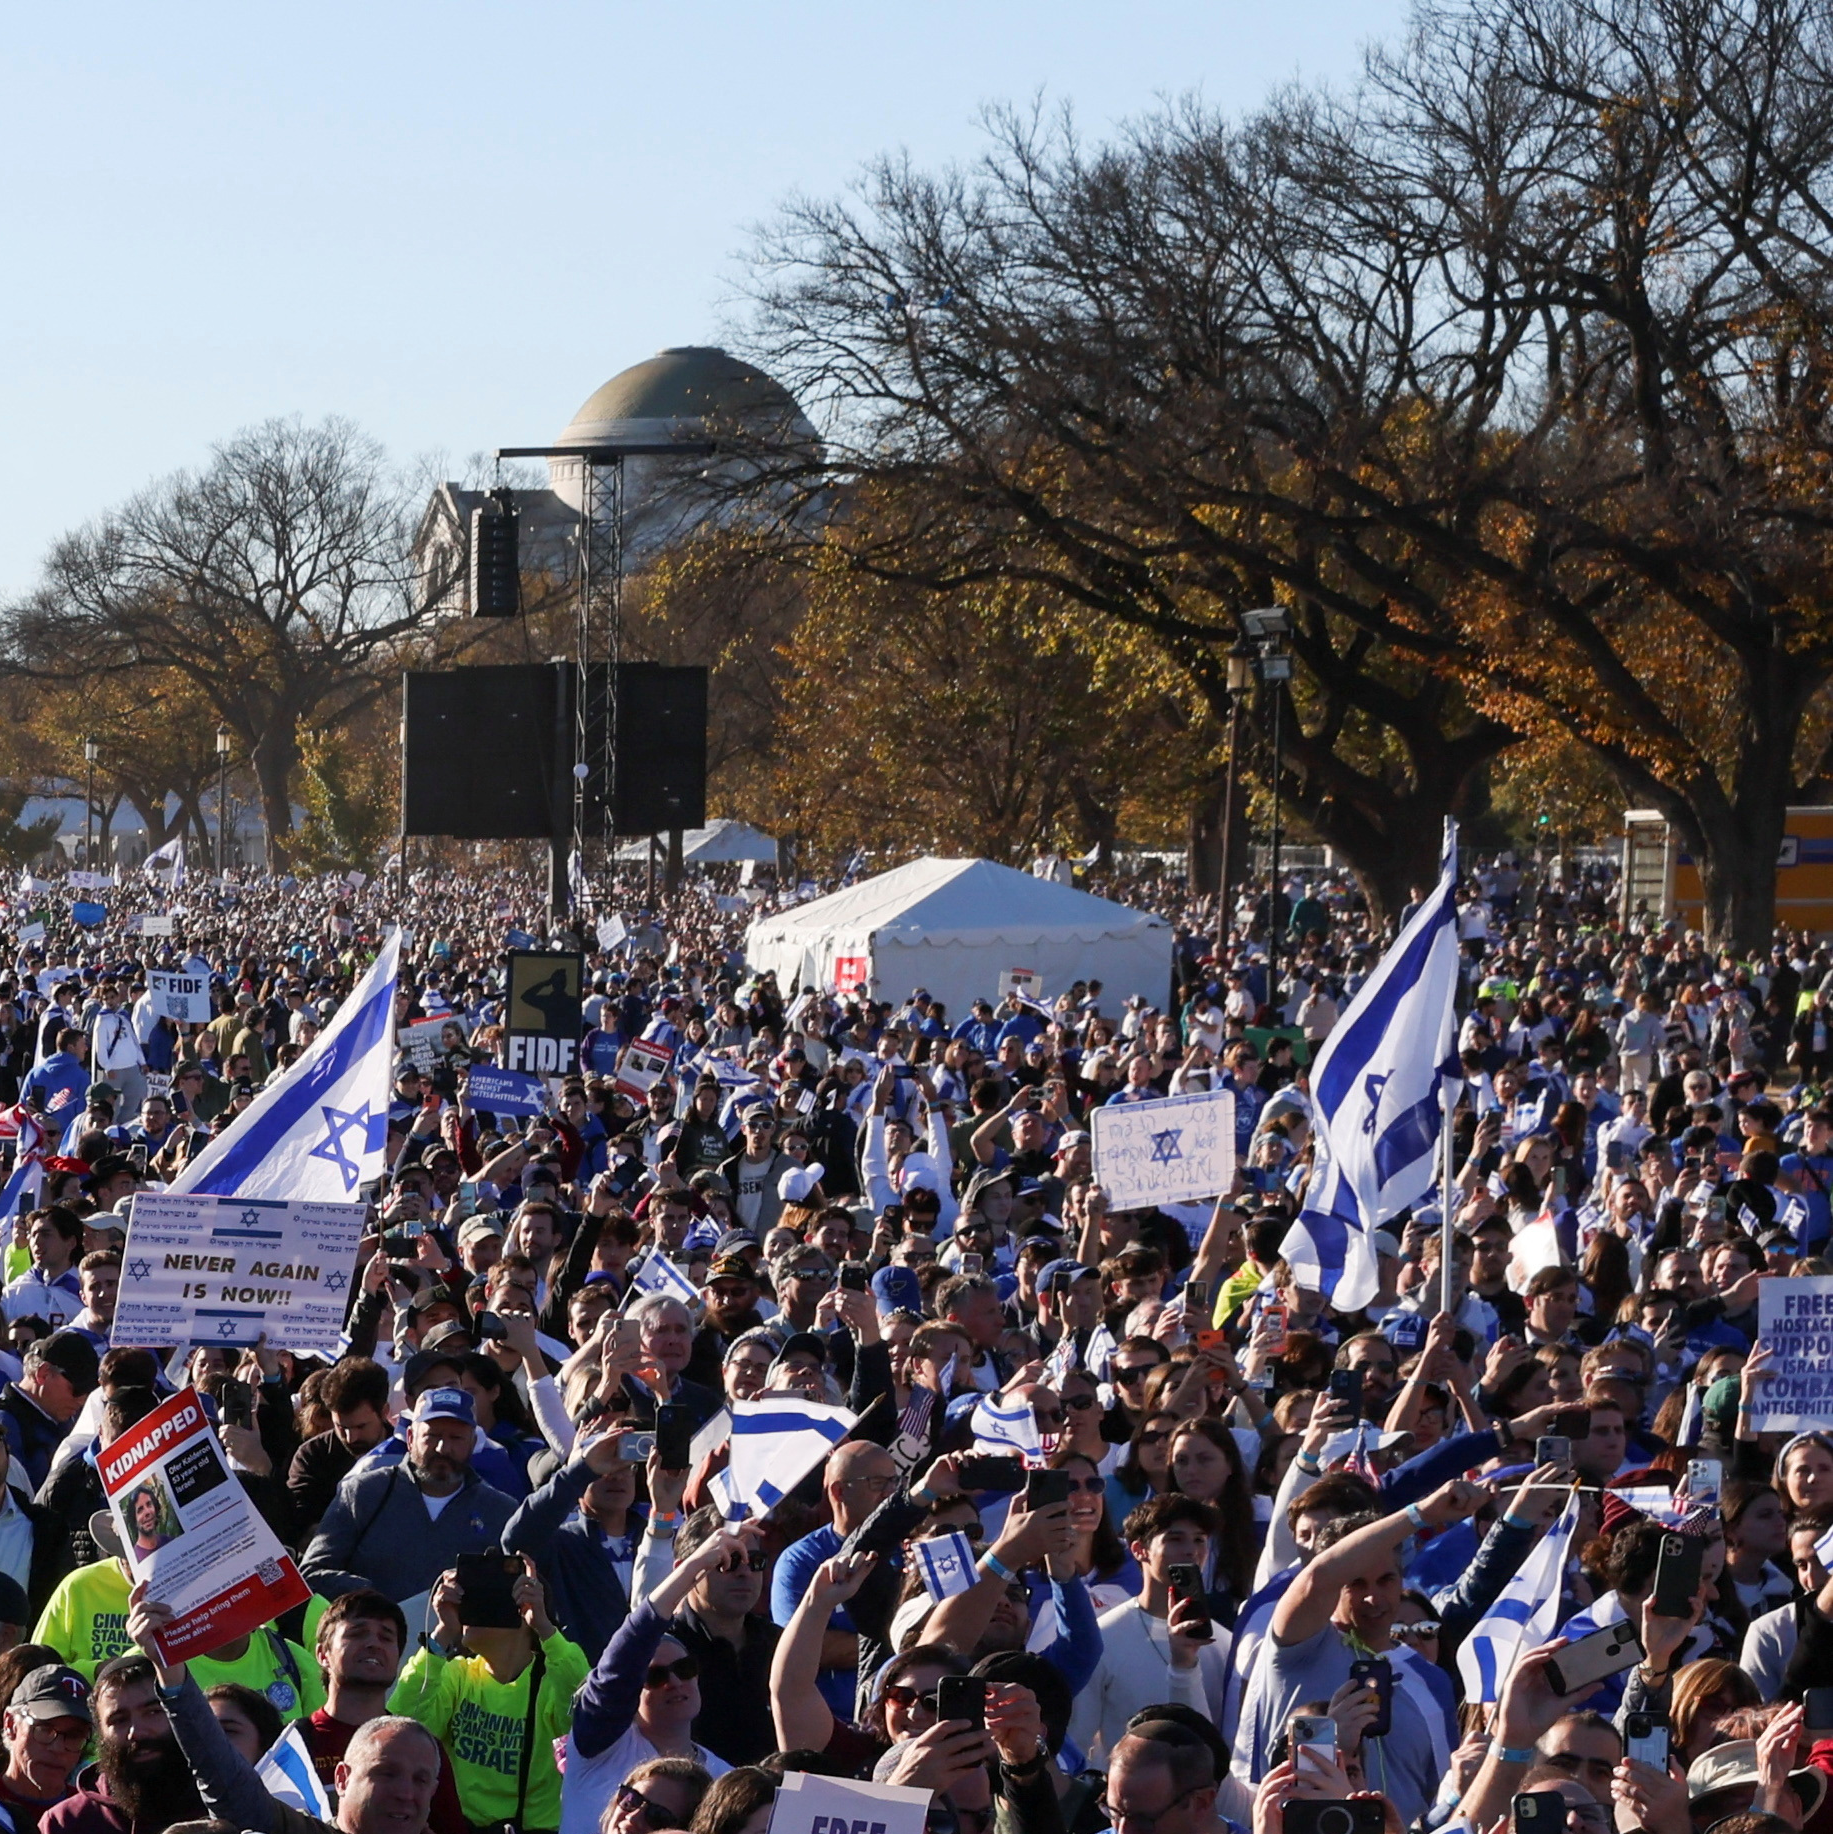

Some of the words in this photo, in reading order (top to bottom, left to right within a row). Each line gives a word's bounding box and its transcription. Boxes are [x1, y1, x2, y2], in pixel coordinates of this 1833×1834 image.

[169, 978, 202, 994] FIDF
[509, 1035, 576, 1073] FIDF
[469, 1083, 502, 1092] AGAINST
[470, 1075, 514, 1087] AMERICANS
[163, 1253, 236, 1273] NEVER
[249, 1261, 320, 1281] AGAIN
[183, 1283, 207, 1299] IS
[220, 1286, 292, 1306] NOW!!
[104, 1405, 198, 1484] KIDNAPPED
[167, 1462, 183, 1476] Ofer
[182, 1445, 211, 1466] Kalderon
[180, 1465, 198, 1479] years
[197, 1457, 210, 1468] old
[176, 1477, 196, 1494] Israeli
[163, 1619, 191, 1639] Please
[191, 1611, 209, 1628] help
[209, 1599, 232, 1618] bring
[230, 1586, 251, 1602] them
[166, 1633, 191, 1647] home
[191, 1622, 214, 1637] alive.
